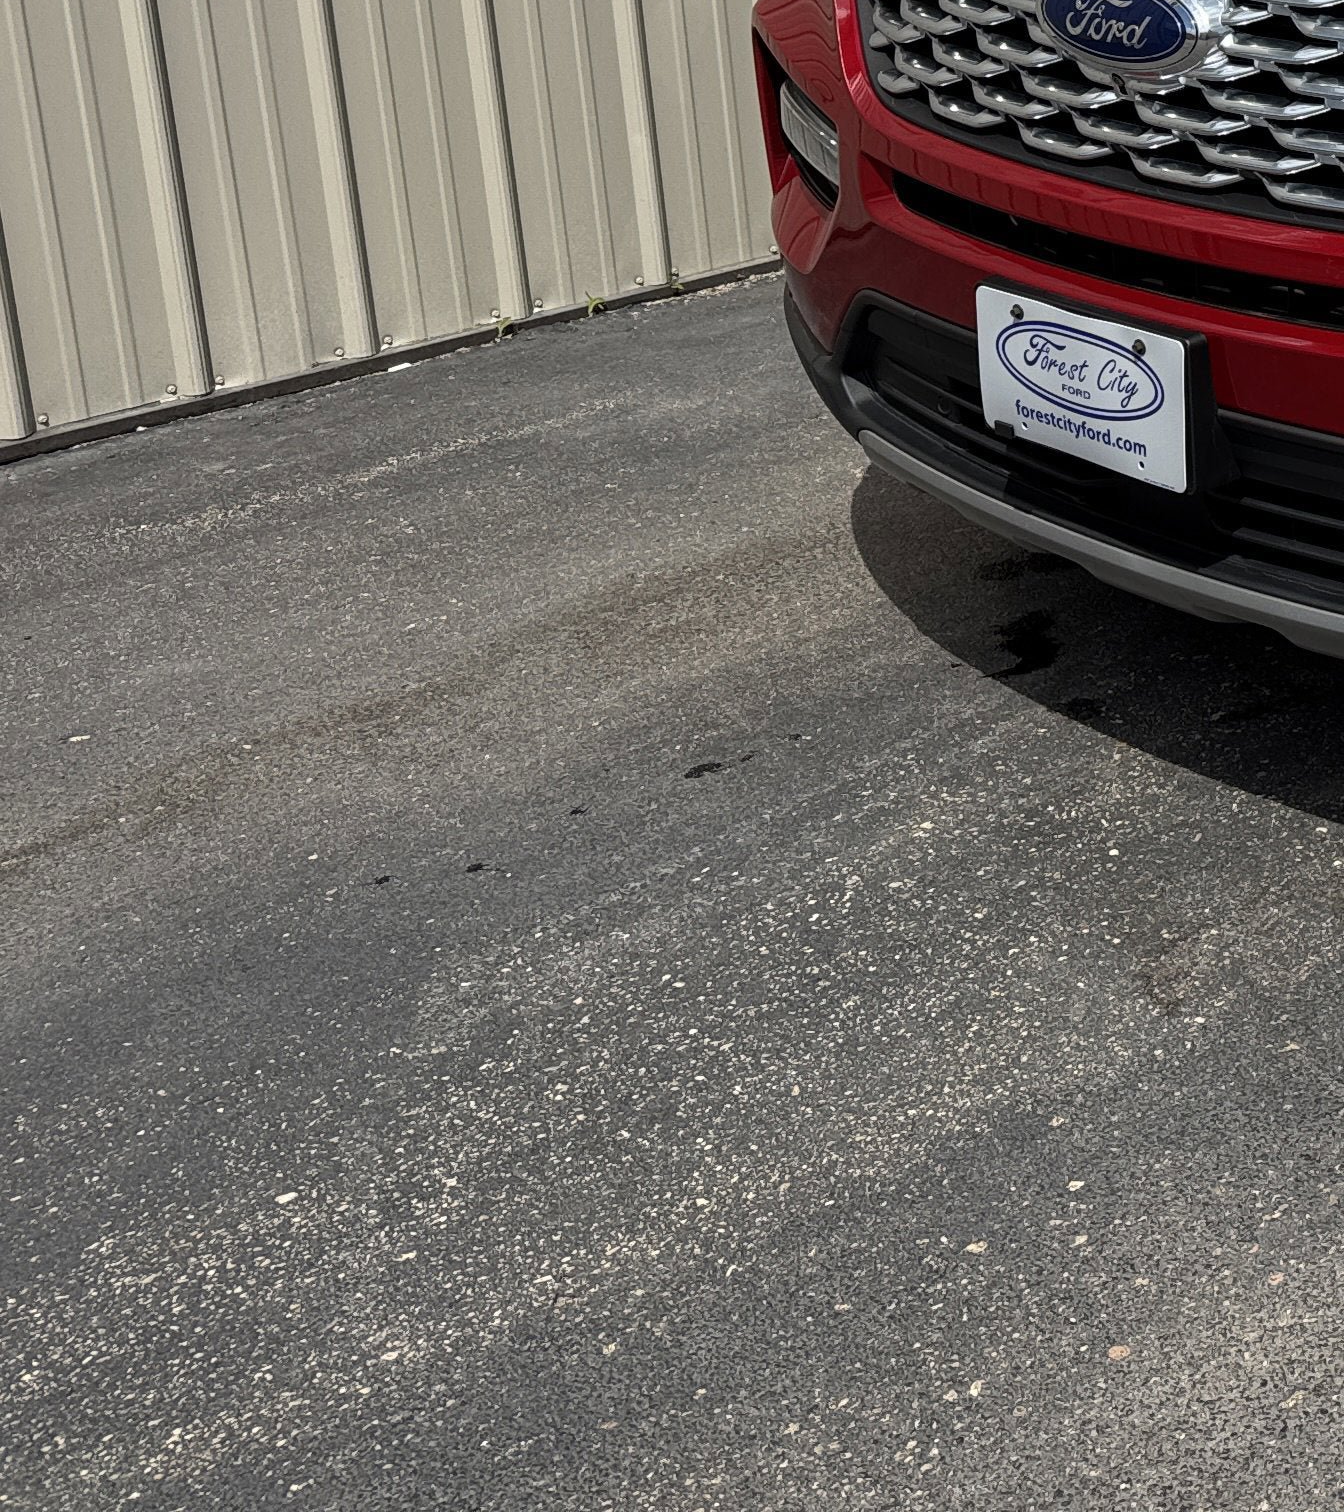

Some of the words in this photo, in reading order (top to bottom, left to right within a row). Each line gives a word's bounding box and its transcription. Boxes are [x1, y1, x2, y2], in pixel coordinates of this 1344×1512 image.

[1024, 334, 1089, 382] Forest
[1097, 359, 1138, 408] City
[1061, 383, 1091, 400] FORD
[1015, 399, 1147, 457] forestcityford.com
